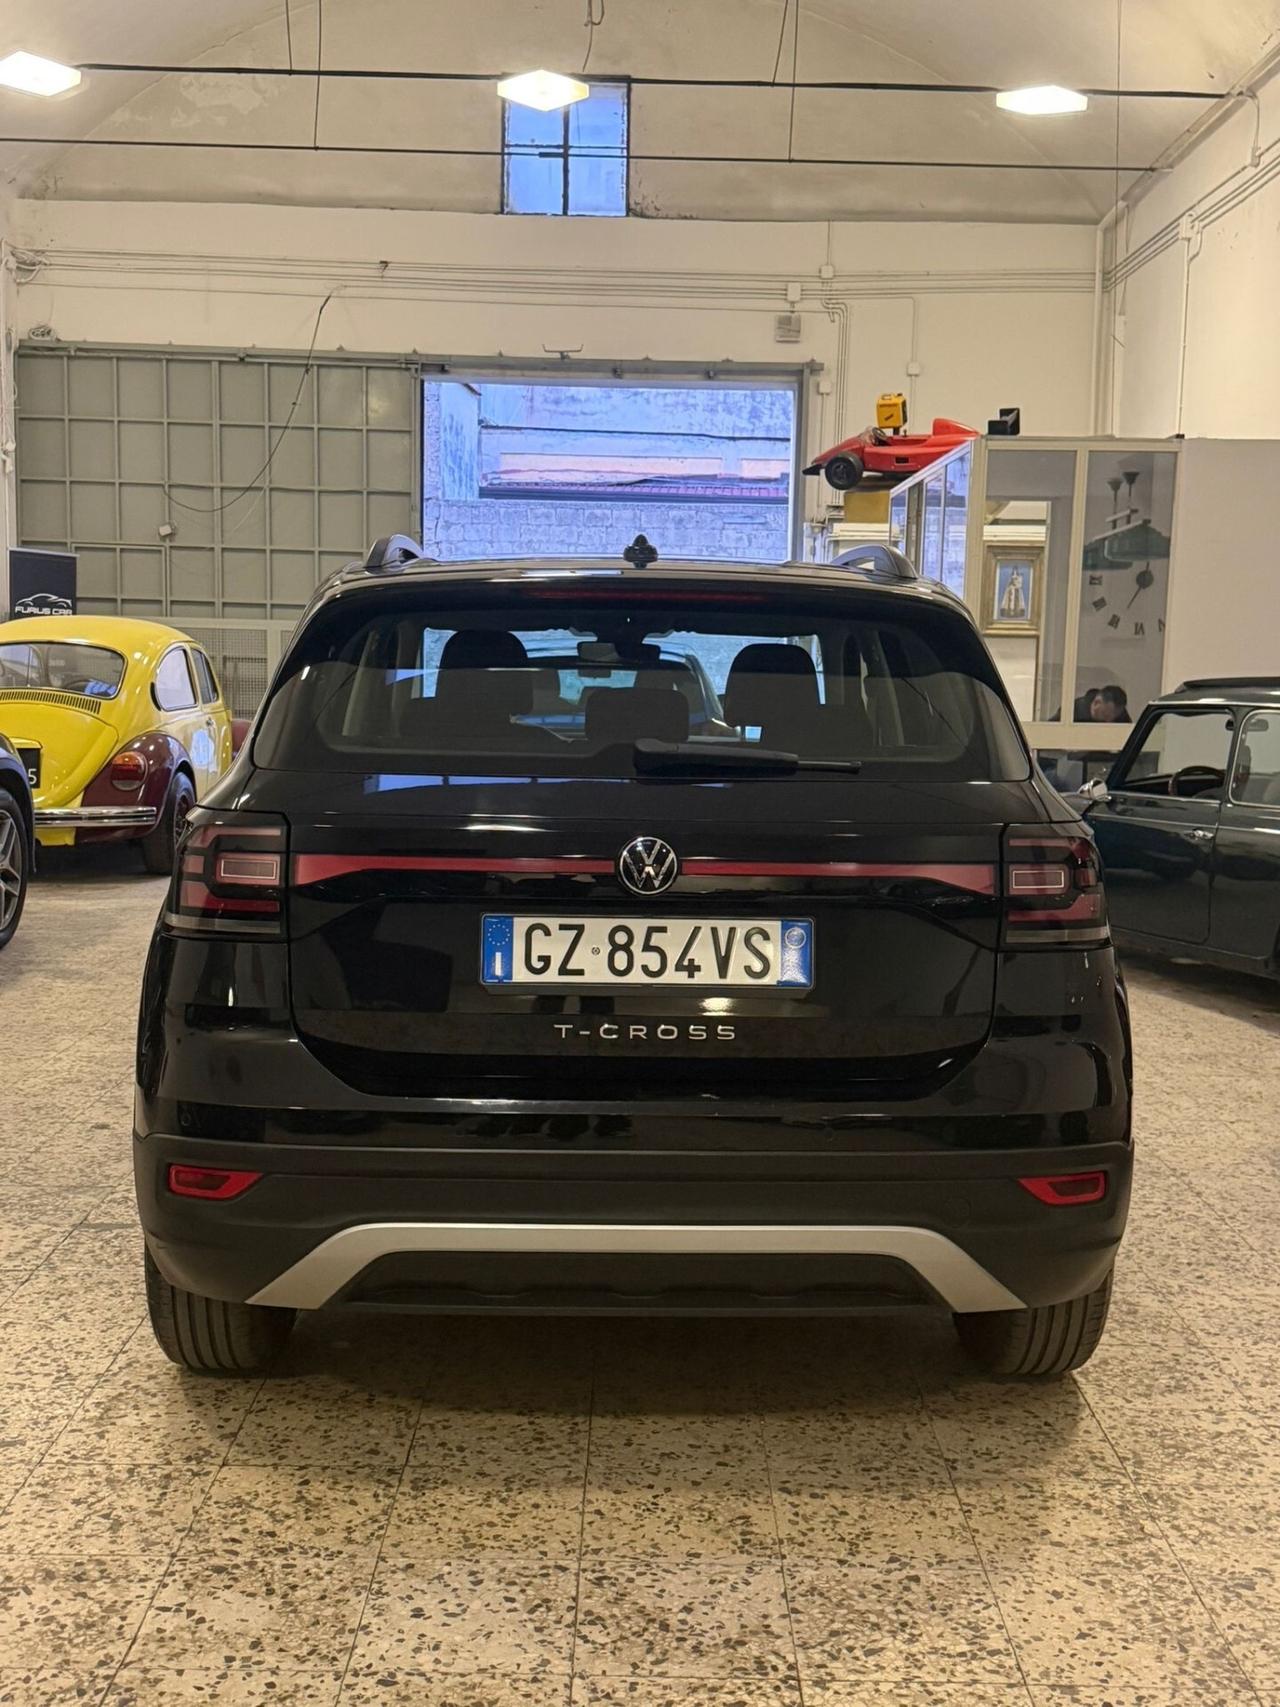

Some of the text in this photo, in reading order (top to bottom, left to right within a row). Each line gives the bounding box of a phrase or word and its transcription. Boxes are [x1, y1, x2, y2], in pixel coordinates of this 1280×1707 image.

[52, 608, 73, 616] CAR
[621, 838, 676, 891] VW
[524, 923, 771, 979] GZ 854VS
[554, 1023, 736, 1040] T-CROSS
